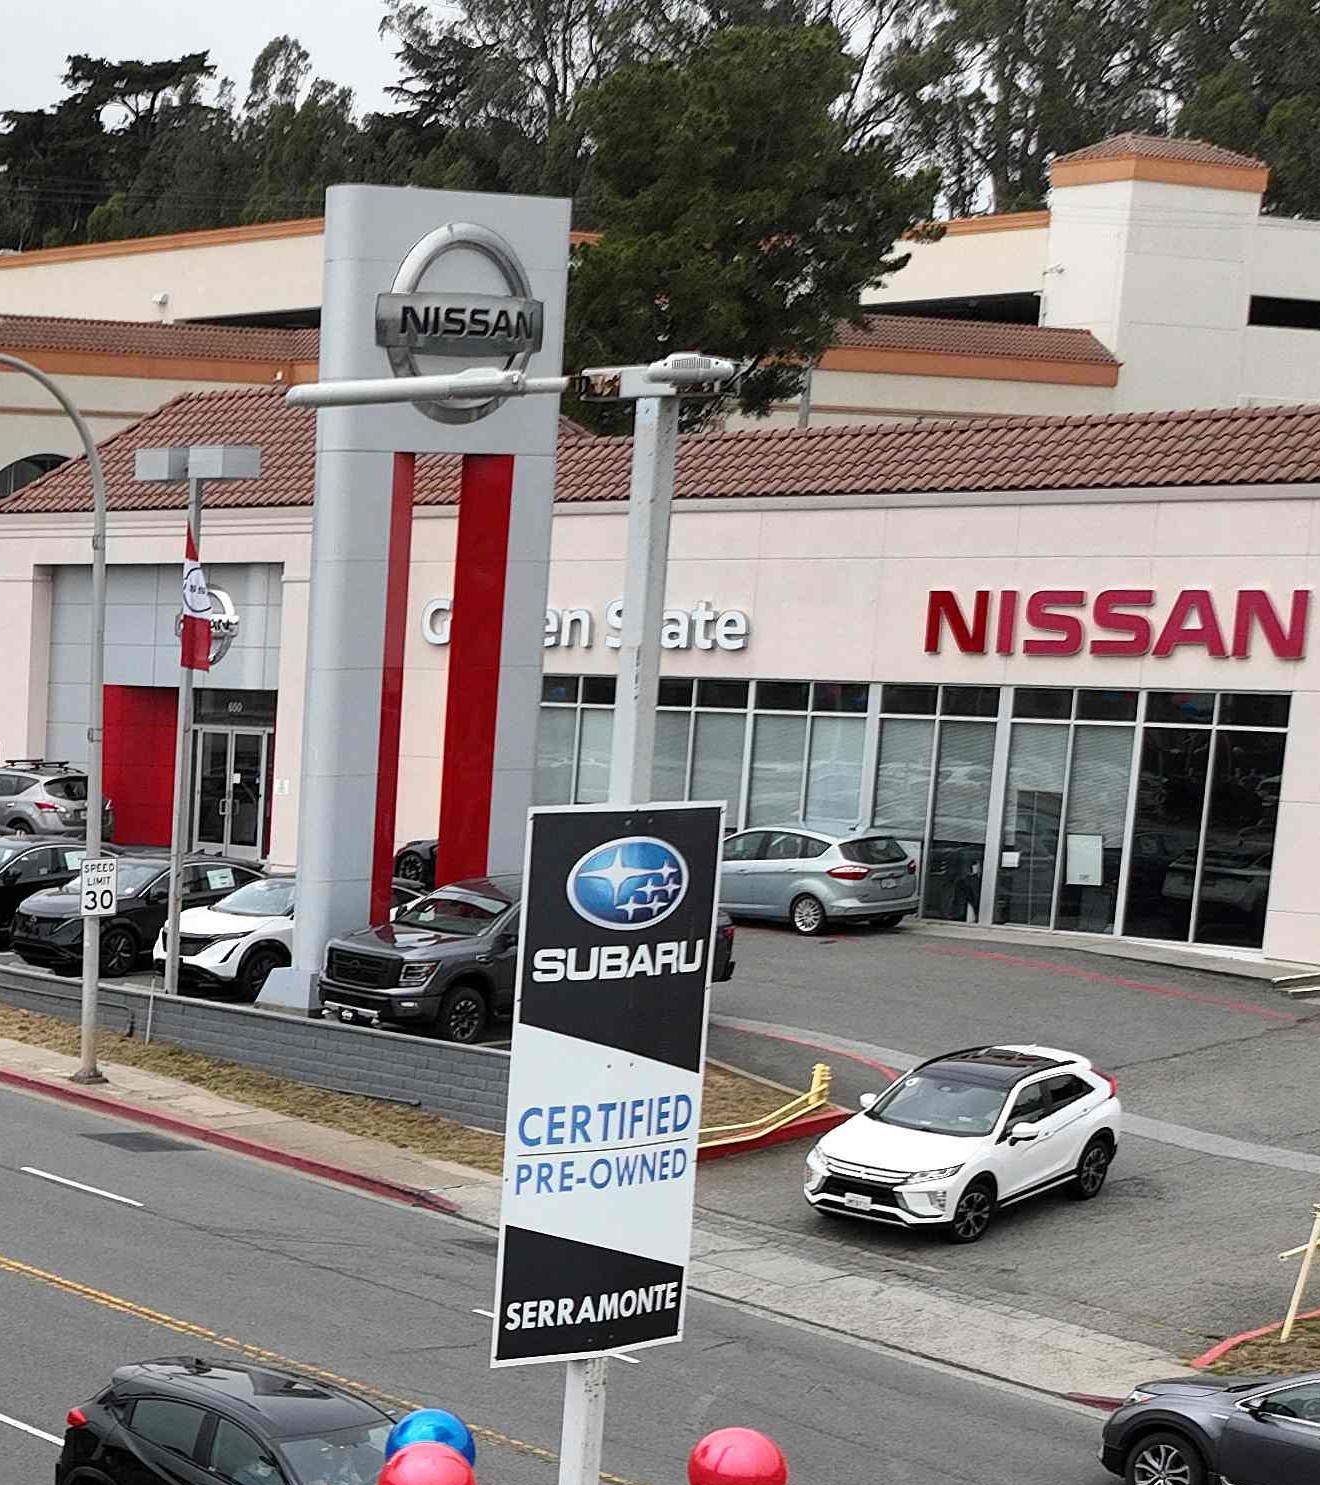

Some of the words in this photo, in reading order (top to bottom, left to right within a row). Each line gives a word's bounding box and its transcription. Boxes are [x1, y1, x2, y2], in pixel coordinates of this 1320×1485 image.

[400, 306, 534, 339] NISSAN
[924, 589, 1311, 659] NISSAN
[84, 863, 115, 873] SPEED
[87, 876, 111, 887] LIMIT
[84, 890, 113, 910] 30
[532, 938, 704, 983] SUBARU
[518, 1094, 693, 1147] CERTIFIED
[514, 1148, 688, 1196] PRE-OWNED
[505, 1281, 679, 1332] SERRAMONTE
